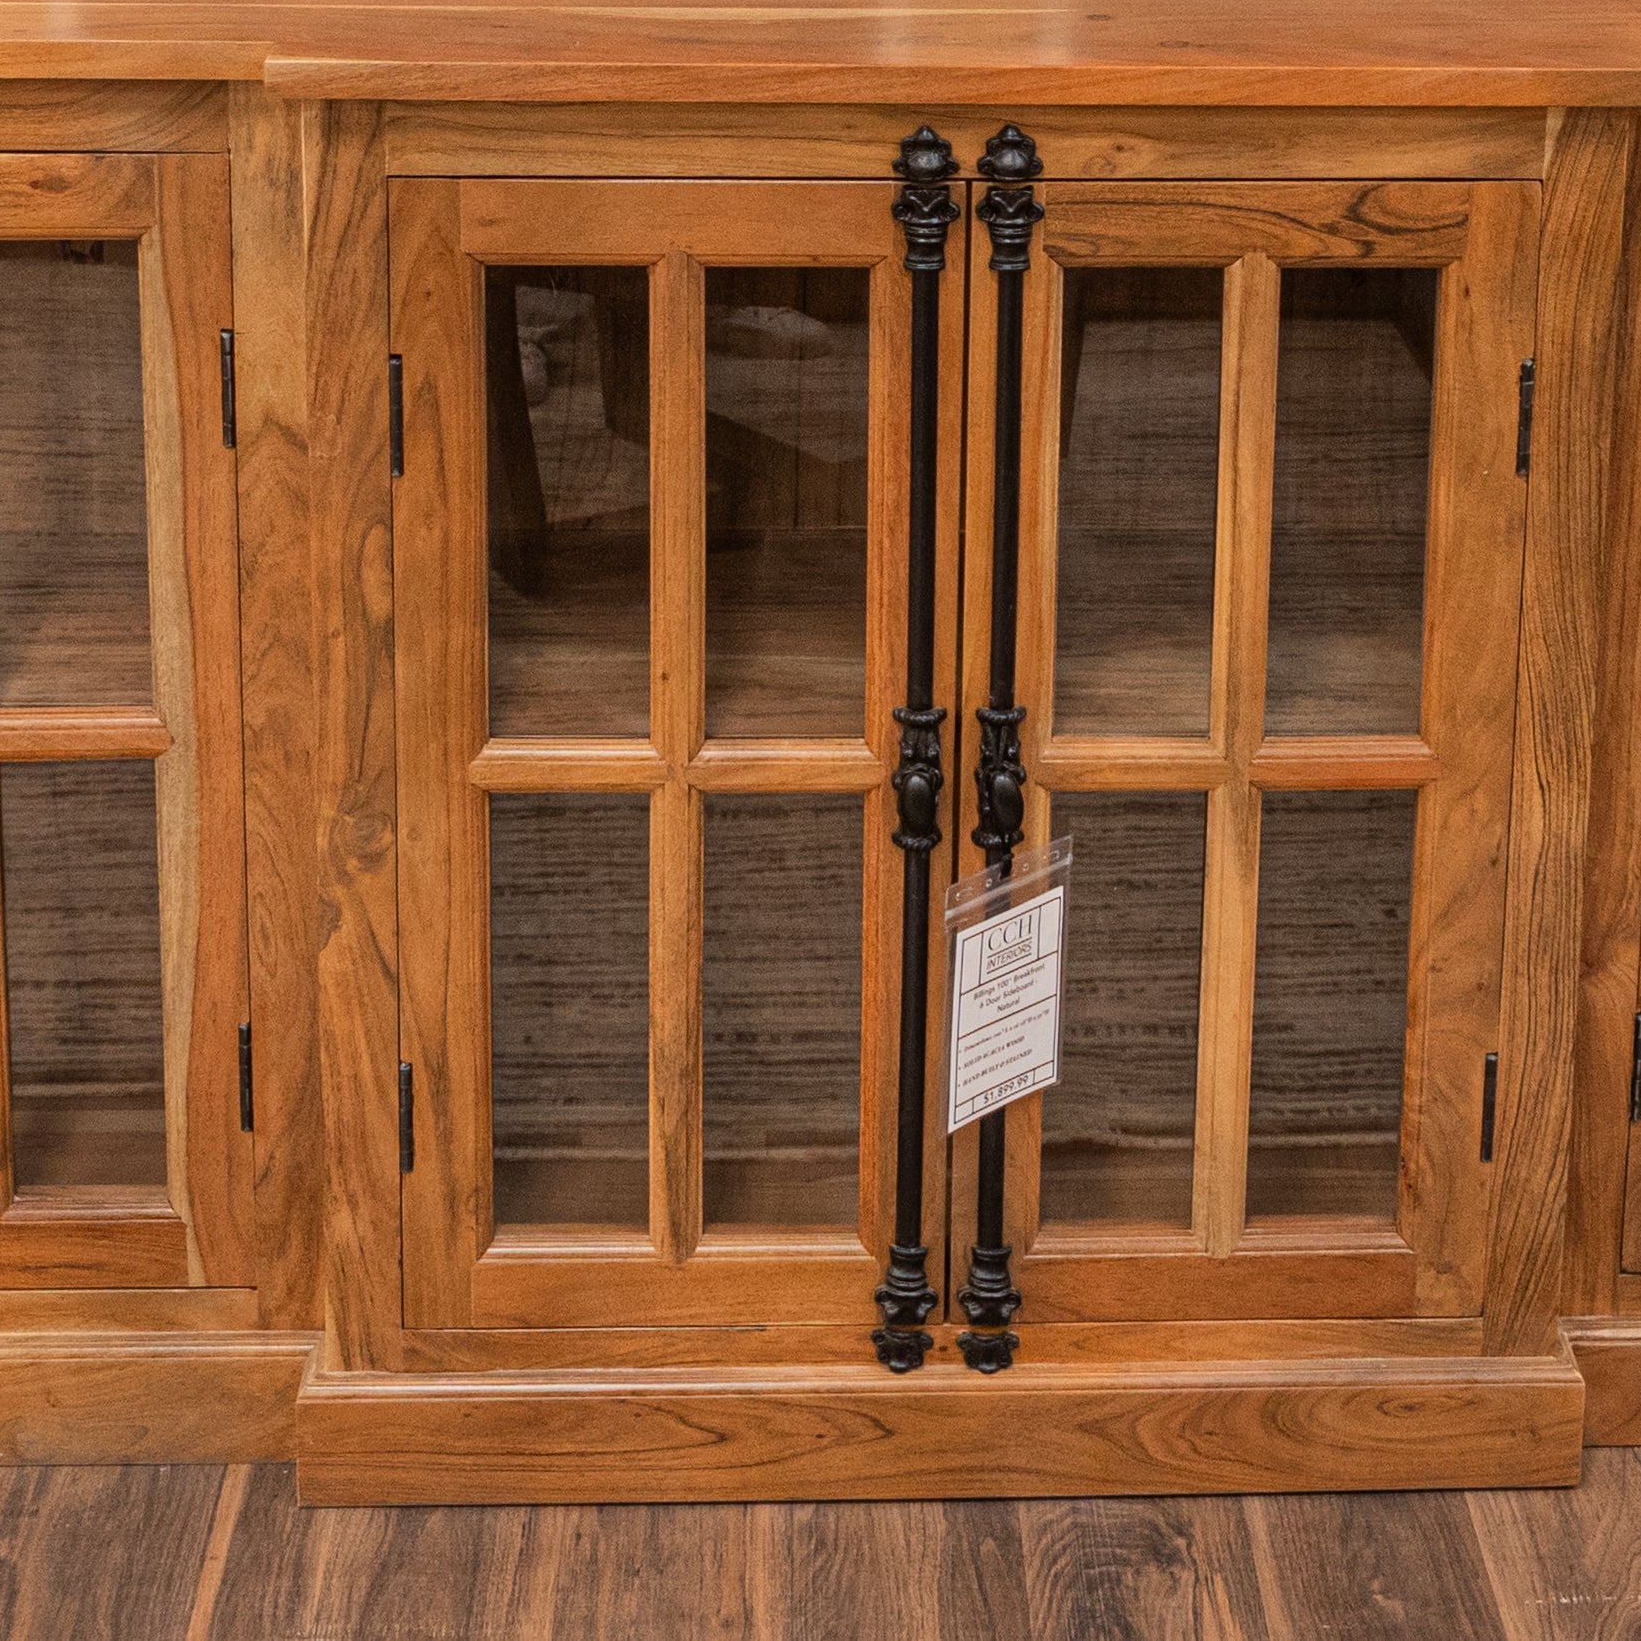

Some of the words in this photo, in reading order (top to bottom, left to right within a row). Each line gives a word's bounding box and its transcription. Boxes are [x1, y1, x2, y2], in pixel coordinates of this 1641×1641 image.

[988, 914, 1032, 951] CCH
[986, 941, 1032, 970] INTERIORS
[997, 996, 1020, 1012] Natural
[982, 1073, 1029, 1105] $1,899.99
